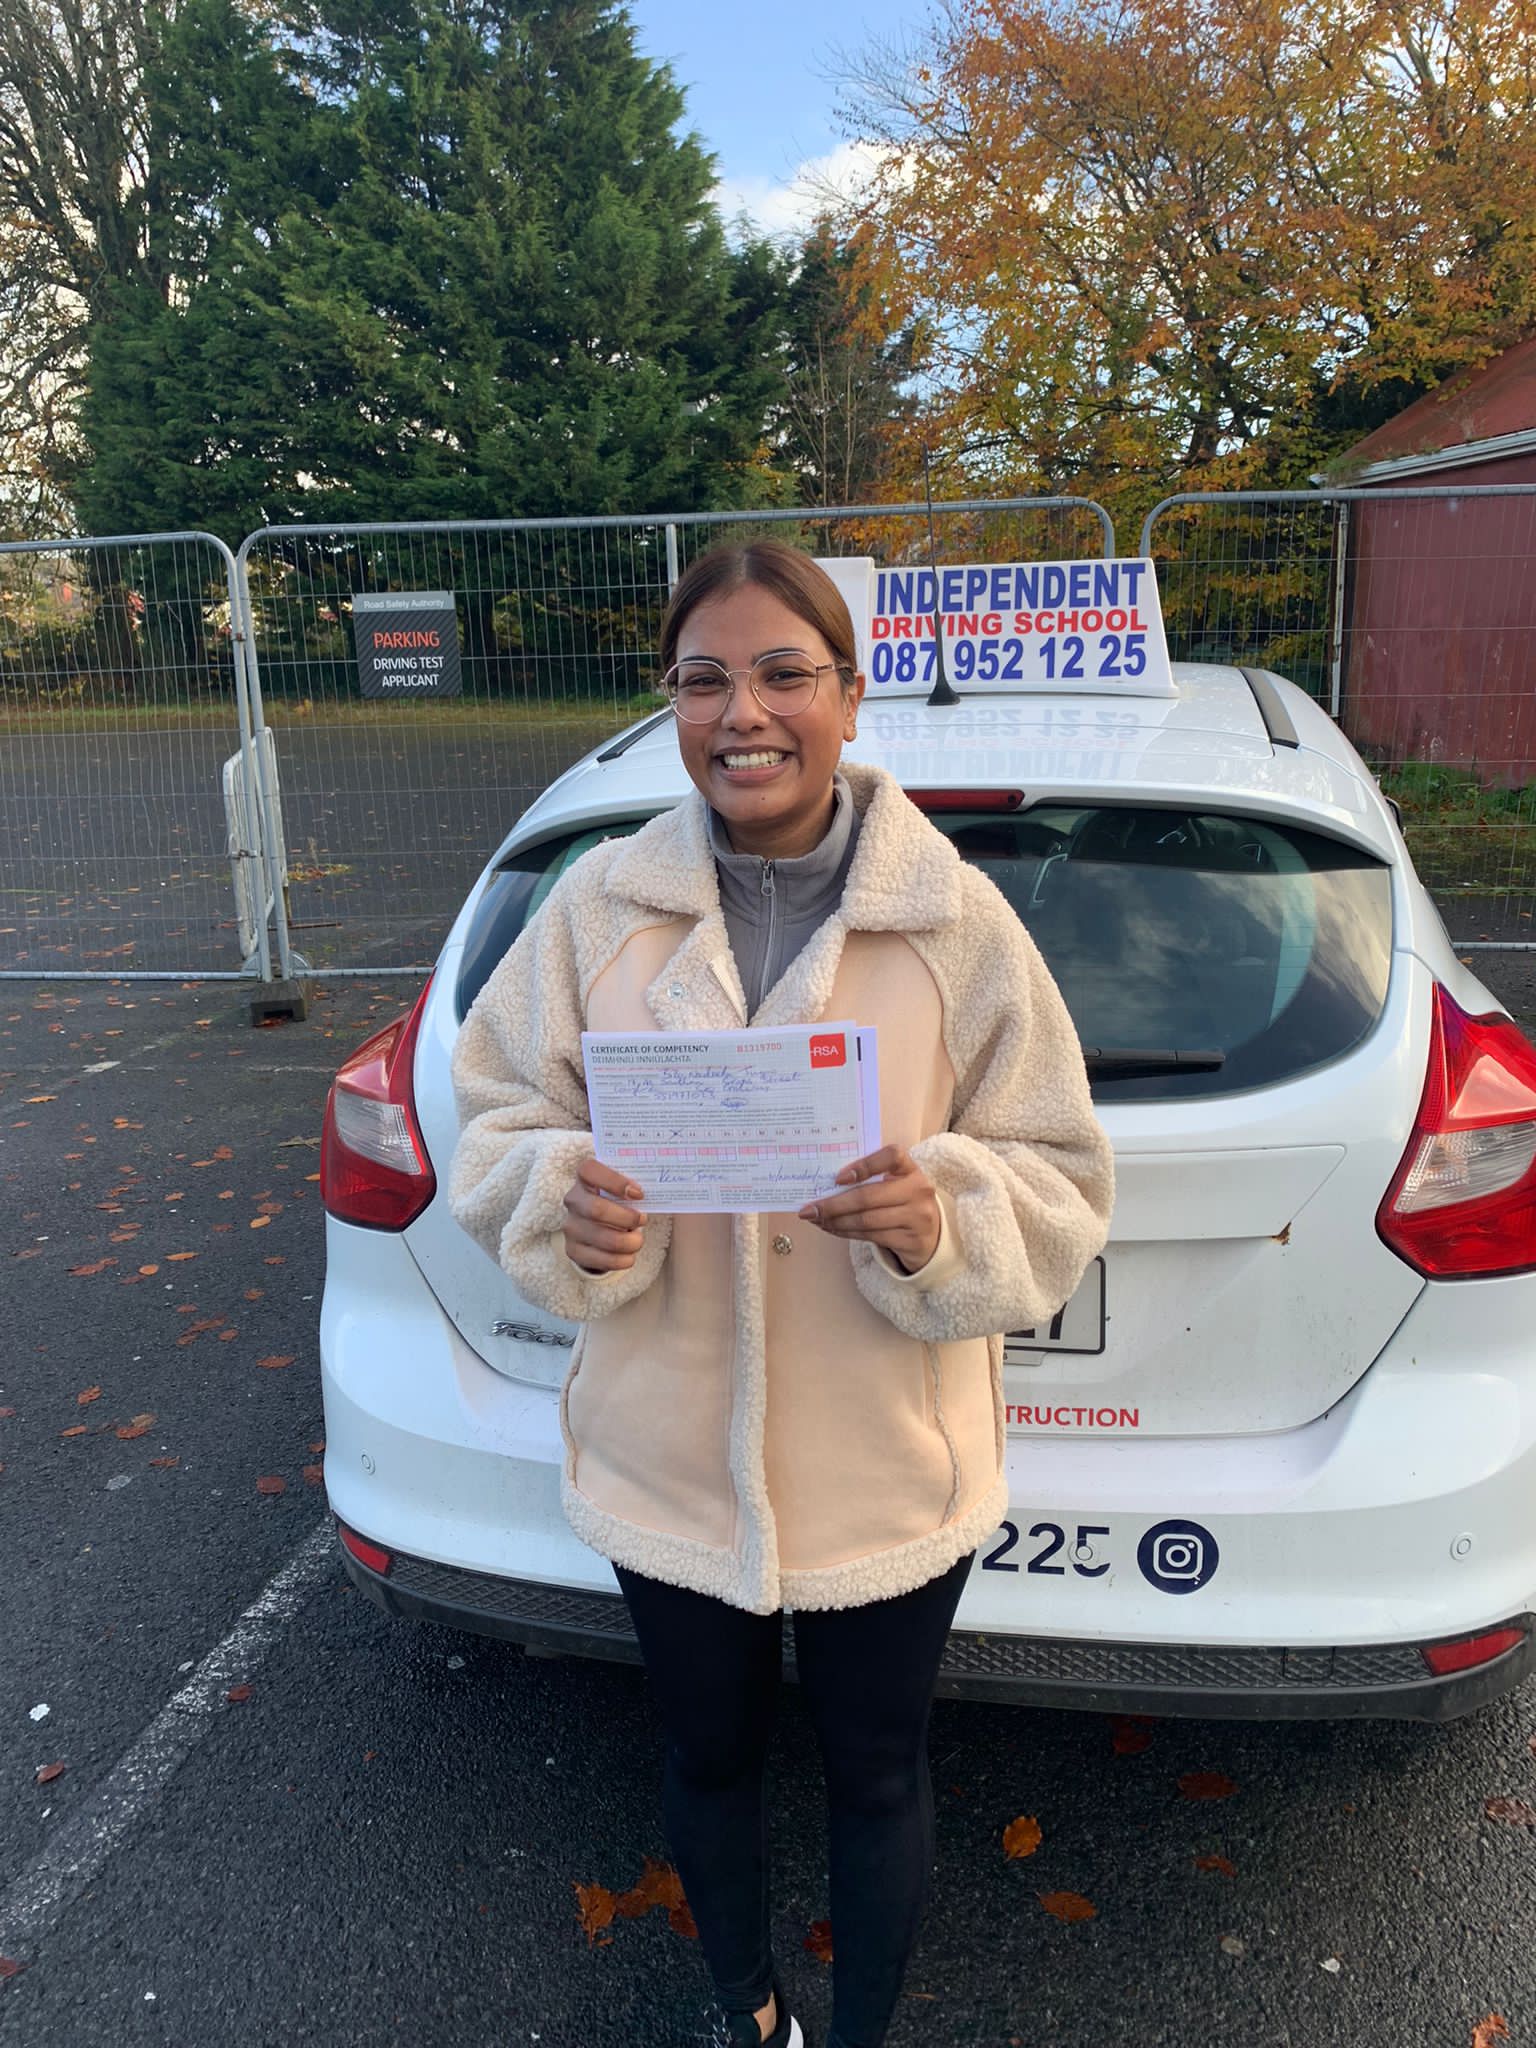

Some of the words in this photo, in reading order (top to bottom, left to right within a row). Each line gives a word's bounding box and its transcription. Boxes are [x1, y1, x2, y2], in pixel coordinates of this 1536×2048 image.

[876, 562, 1146, 615] INDEPENDENT
[363, 600, 385, 609] Road
[386, 600, 410, 610] Safety
[411, 599, 445, 609] Authority
[871, 612, 1003, 640] DRIVING
[1013, 608, 1148, 635] SCHOOL
[373, 631, 440, 649] PARKING
[373, 657, 418, 670] DRIVING
[418, 656, 444, 669] TEST
[871, 641, 939, 684] 087
[953, 638, 1024, 681] 952
[1039, 635, 1085, 680] 12
[1097, 633, 1148, 678] 25
[382, 674, 440, 688] APPLICANT
[591, 1045, 639, 1054] CERTIFICATE
[641, 1045, 652, 1054] OF
[653, 1044, 709, 1054] COMPETENCY
[813, 1045, 839, 1057] RSA
